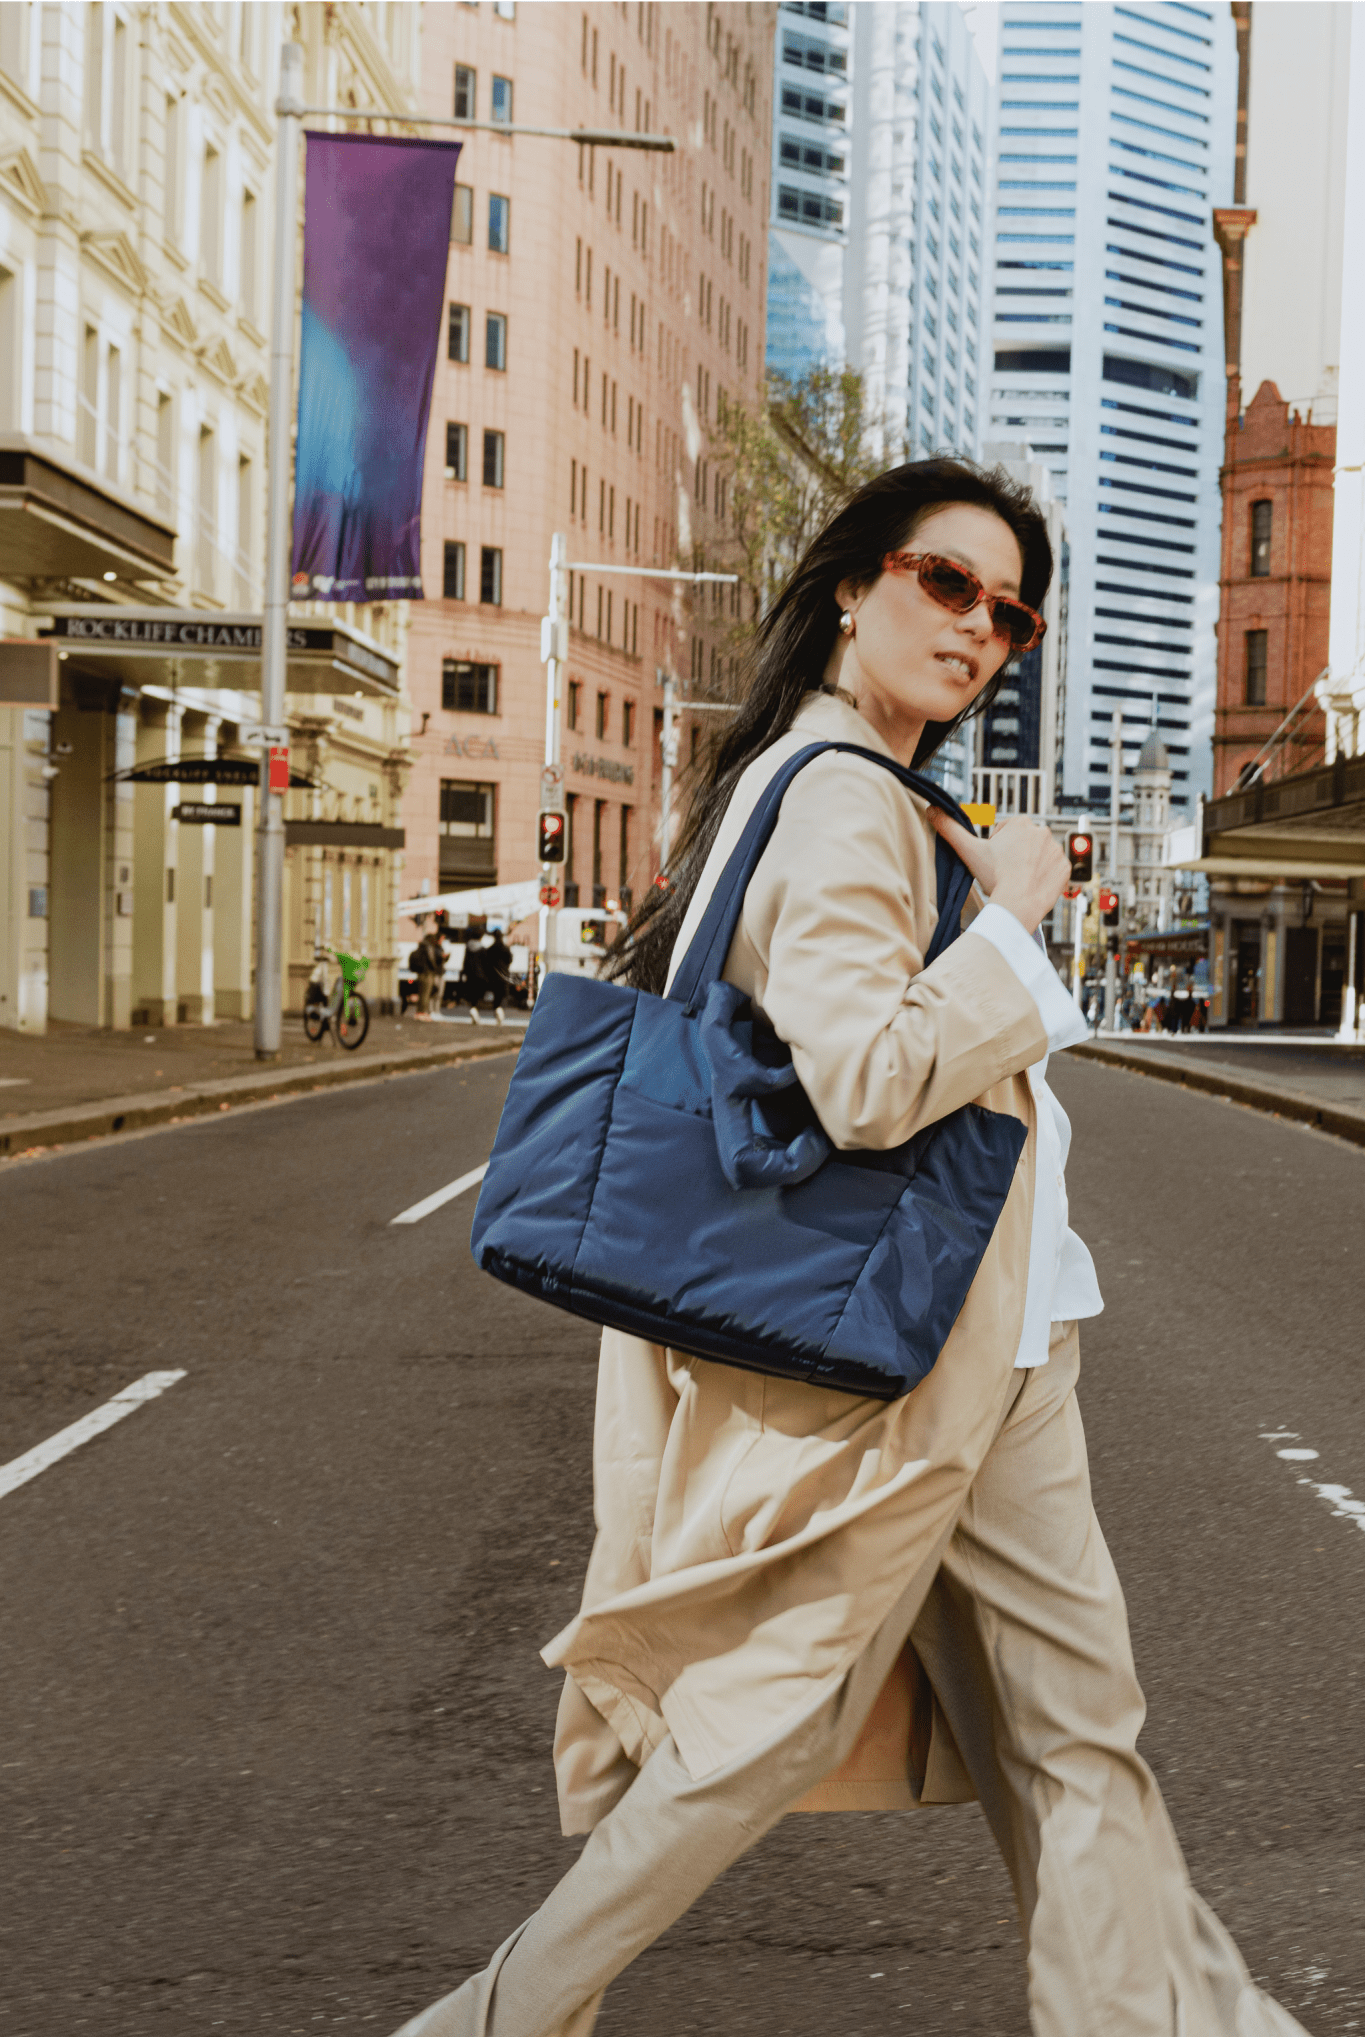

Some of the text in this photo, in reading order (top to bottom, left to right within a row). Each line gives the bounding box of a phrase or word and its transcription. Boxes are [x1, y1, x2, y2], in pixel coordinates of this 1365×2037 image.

[68, 618, 307, 648] ROCKLIFF CHAMRS
[445, 733, 499, 761] ACA
